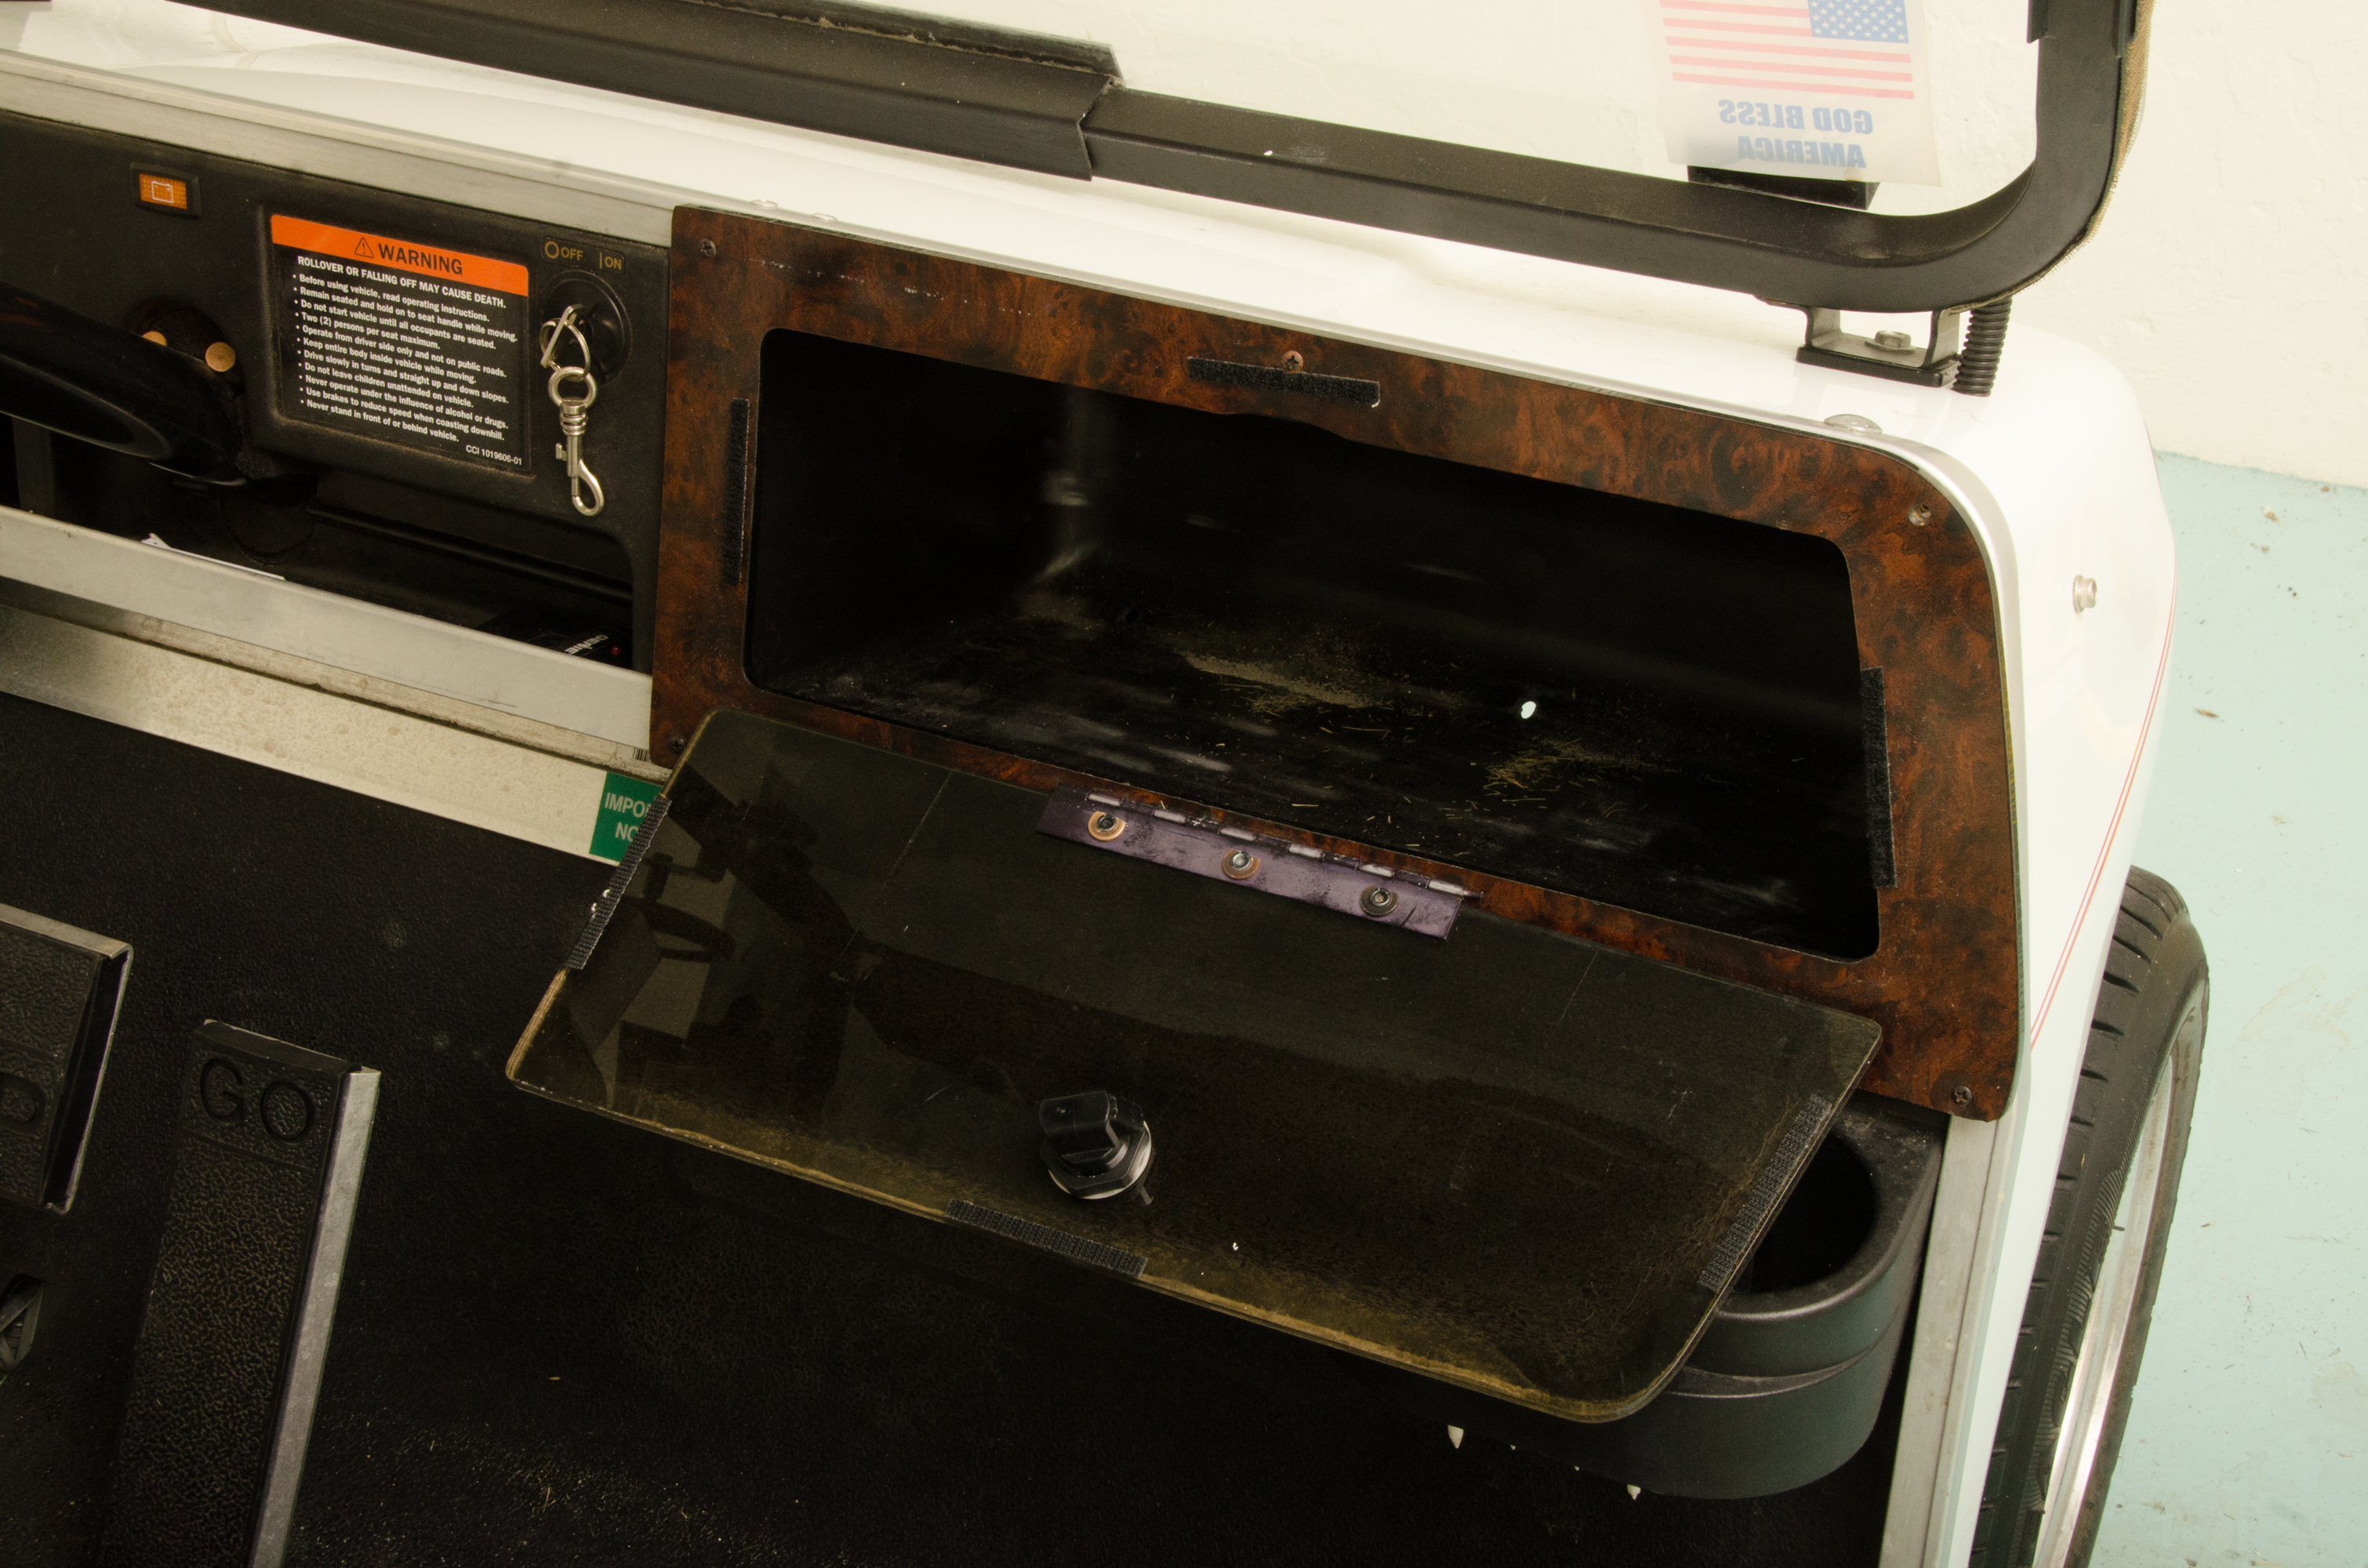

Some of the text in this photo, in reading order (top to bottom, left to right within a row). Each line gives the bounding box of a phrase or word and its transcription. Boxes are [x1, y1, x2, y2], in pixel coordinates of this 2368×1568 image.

[378, 243, 463, 275] WARNING
[561, 247, 583, 260] OFF
[605, 256, 622, 270] ON
[297, 256, 506, 308] ROLLOVER OR FALLING OFF MAY CAUSE DEATH.
[299, 274, 489, 321] Before using vehicle, read operating instructions.
[300, 286, 329, 299] Remain
[331, 295, 358, 306] seated
[376, 303, 393, 314] hold
[407, 310, 416, 318] to
[417, 313, 435, 323] seat
[436, 316, 463, 328] handle
[464, 323, 485, 334] while
[487, 328, 518, 342] moving.
[300, 299, 311, 308] Do
[314, 303, 326, 312] not
[329, 307, 347, 317] start
[349, 311, 377, 322] vehicle
[379, 318, 397, 327] until
[398, 321, 409, 329] all
[410, 325, 451, 339] occupants
[467, 337, 496, 349] seated.
[301, 312, 318, 322] Two
[319, 316, 331, 327] (2)
[333, 321, 365, 332] persons
[380, 331, 398, 340] seat
[400, 335, 440, 349] maximum.
[302, 325, 332, 338] Operate
[334, 332, 352, 343] from
[354, 336, 376, 347] driver
[378, 342, 394, 351] side
[396, 347, 412, 358] only
[415, 350, 429, 359] and
[430, 354, 444, 363] not
[457, 361, 481, 372] public
[482, 366, 506, 377] roads.
[303, 337, 476, 384] Keep entire body inside vehicle while moving.
[303, 350, 508, 403] Drive slowly in turns and straight up and down slopes.
[304, 362, 315, 372] Do
[332, 368, 352, 379] leave
[354, 374, 385, 387] children
[387, 383, 430, 397] unattended
[444, 395, 473, 408] vehicle.
[305, 375, 328, 387] Never
[329, 382, 358, 394] operate
[360, 389, 382, 399] under
[383, 393, 397, 402] the
[398, 396, 434, 411] influence
[445, 408, 473, 420] alcohol
[485, 416, 508, 429] drugs.
[306, 387, 321, 397] Use
[322, 390, 348, 403] brakes
[361, 401, 387, 412] reduce
[388, 408, 412, 418] speed
[413, 413, 434, 423] when
[435, 419, 469, 433] coasting
[470, 426, 504, 440] downhill.
[307, 399, 329, 411] Never
[330, 406, 351, 416] stand
[354, 410, 361, 419] in
[362, 412, 381, 423] front
[402, 421, 427, 434] behind
[430, 430, 459, 441] vehicle.
[466, 445, 522, 465] CCI 1019606-01
[200, 1058, 314, 1143] GO
